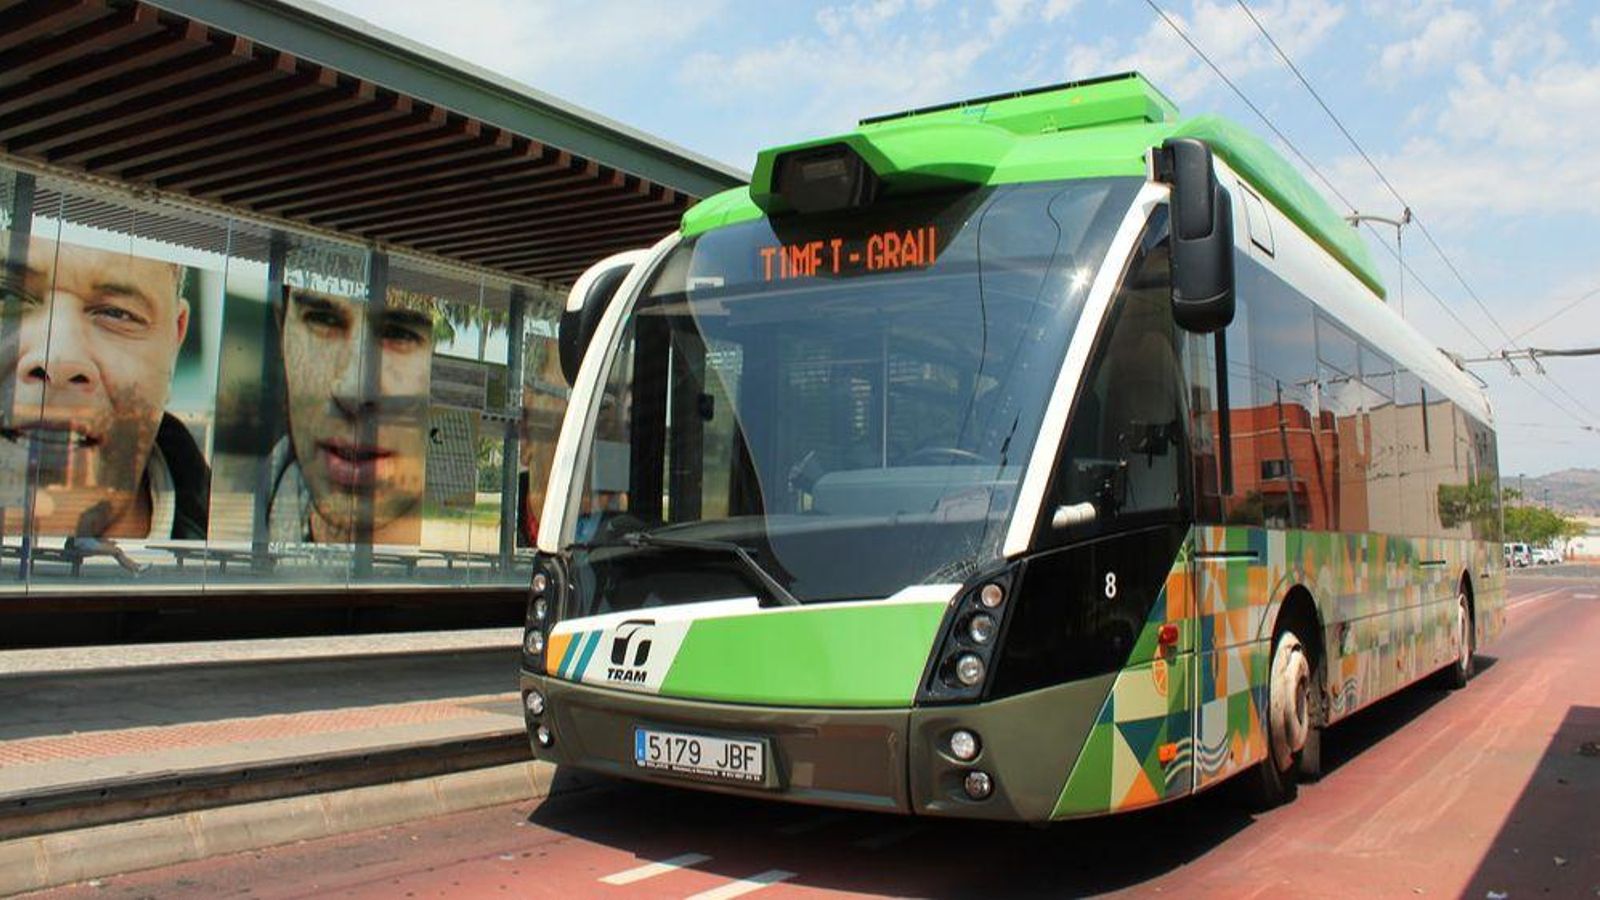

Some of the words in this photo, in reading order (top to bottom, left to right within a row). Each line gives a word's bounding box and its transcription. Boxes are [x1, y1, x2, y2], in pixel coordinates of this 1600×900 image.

[1105, 572, 1116, 599] 8
[608, 668, 647, 683] TRAM
[649, 735, 701, 765] 5179
[717, 743, 756, 770] JBF
